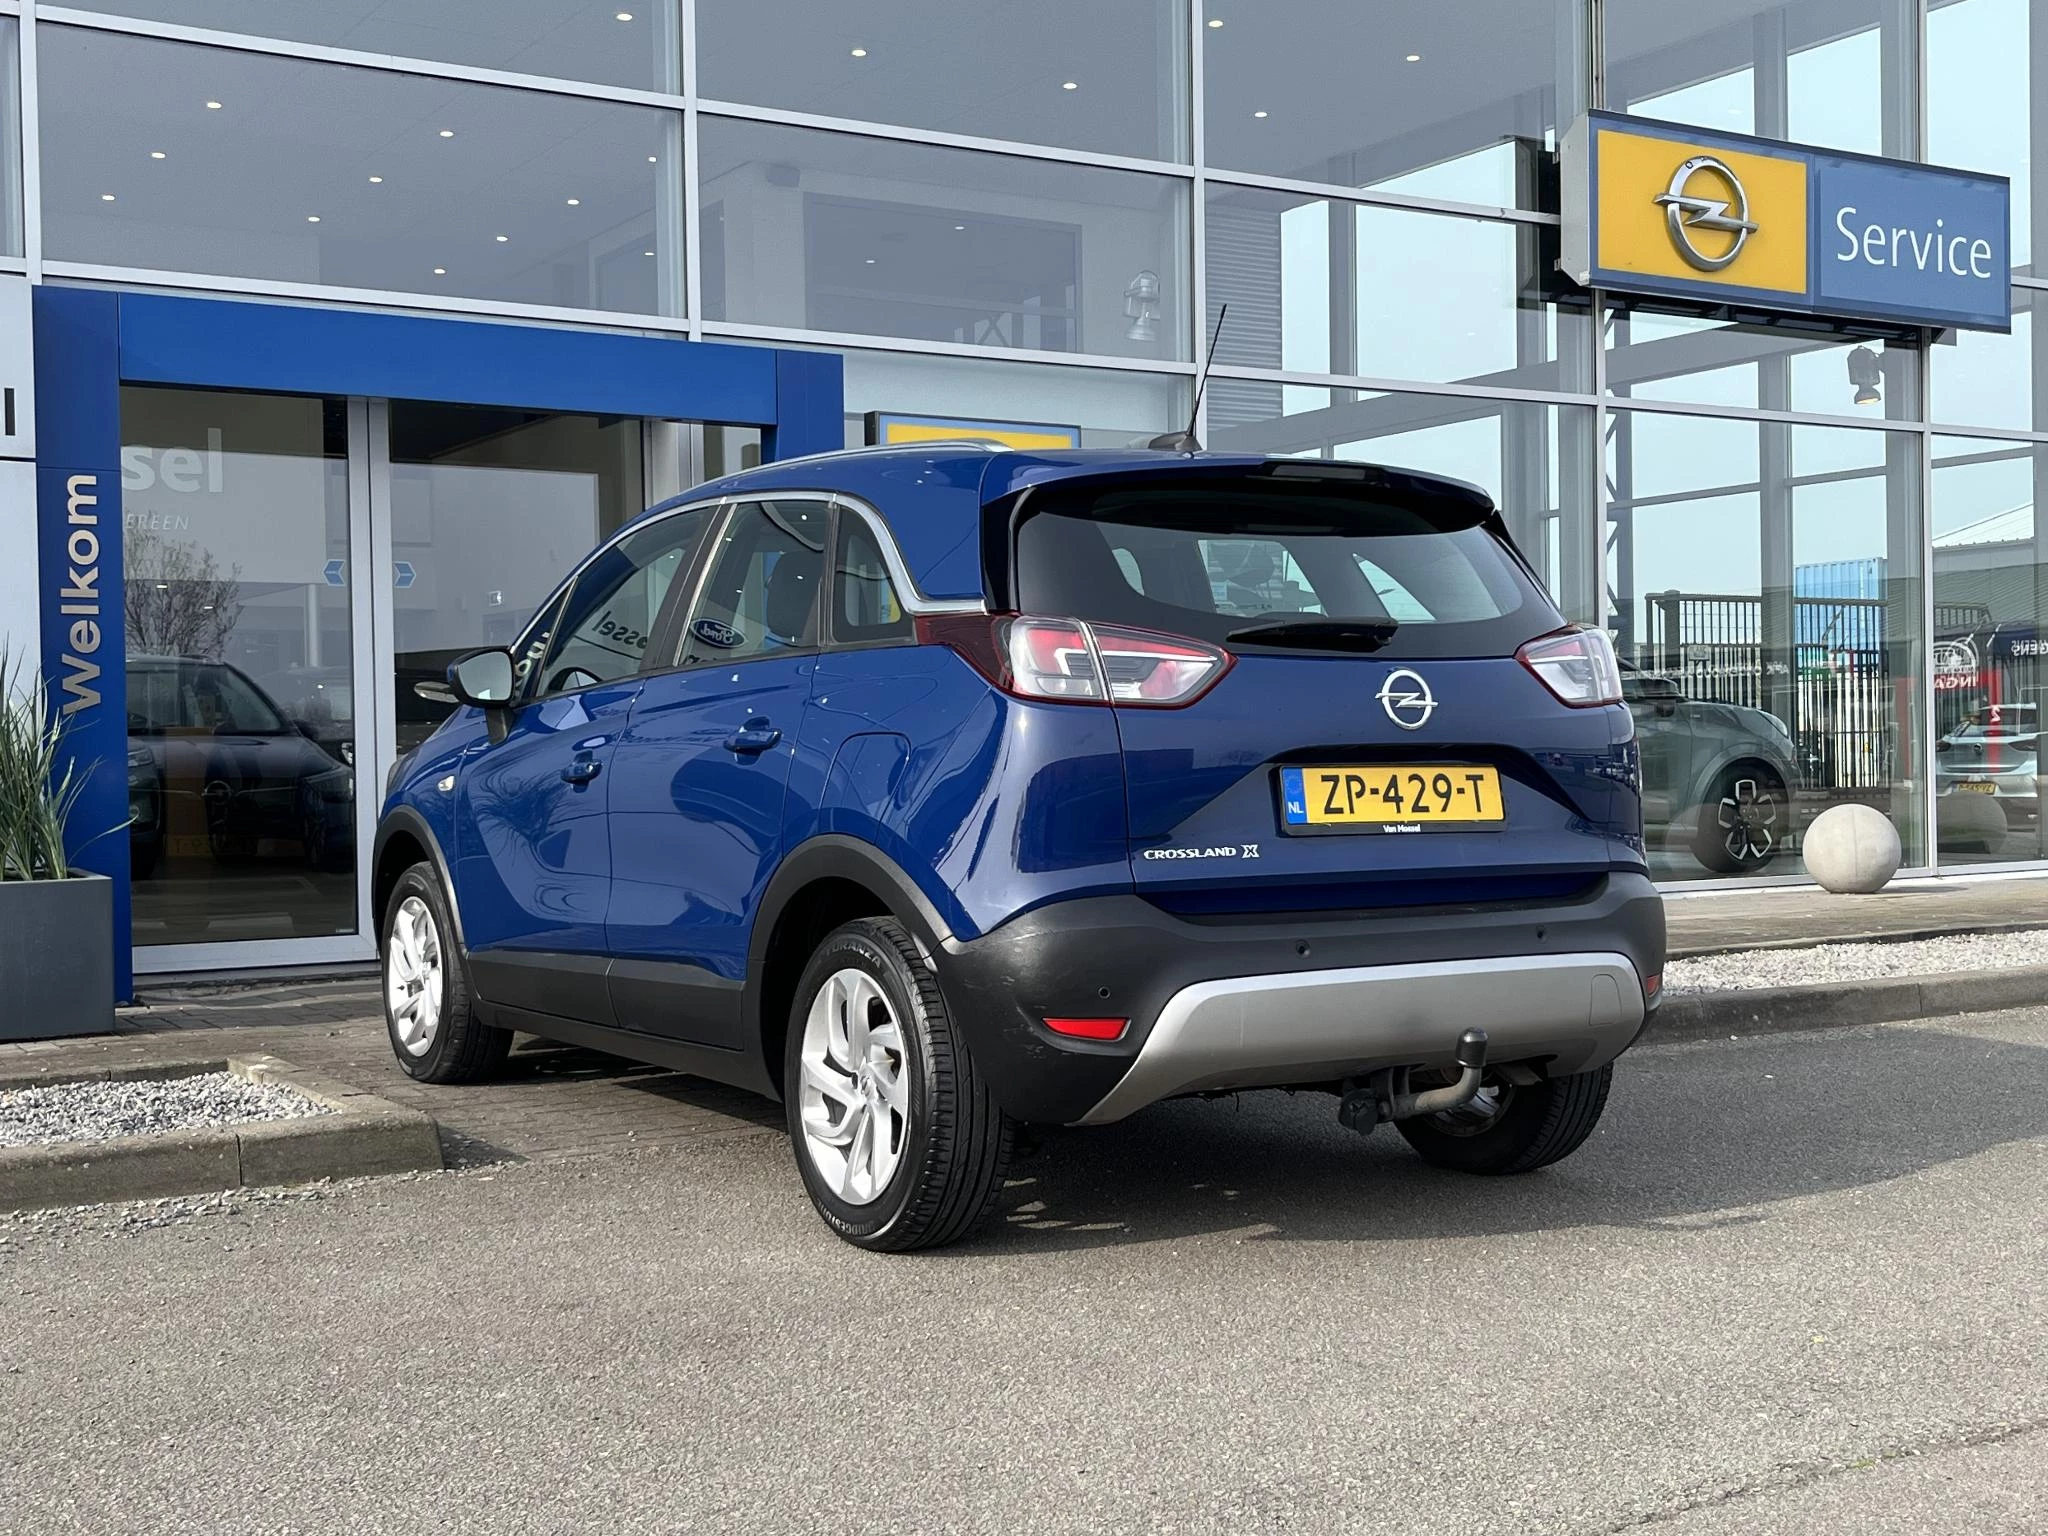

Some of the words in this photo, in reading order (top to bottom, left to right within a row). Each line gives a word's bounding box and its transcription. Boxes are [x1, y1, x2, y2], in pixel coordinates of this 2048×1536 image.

[1836, 206, 1992, 279] Service
[60, 474, 101, 715] Welkom
[1287, 802, 1304, 814] NL
[1320, 773, 1485, 815] ZP-429-T
[1382, 824, 1397, 833] Van
[1143, 846, 1237, 860] CROSSLAND
[1240, 844, 1260, 859] X
